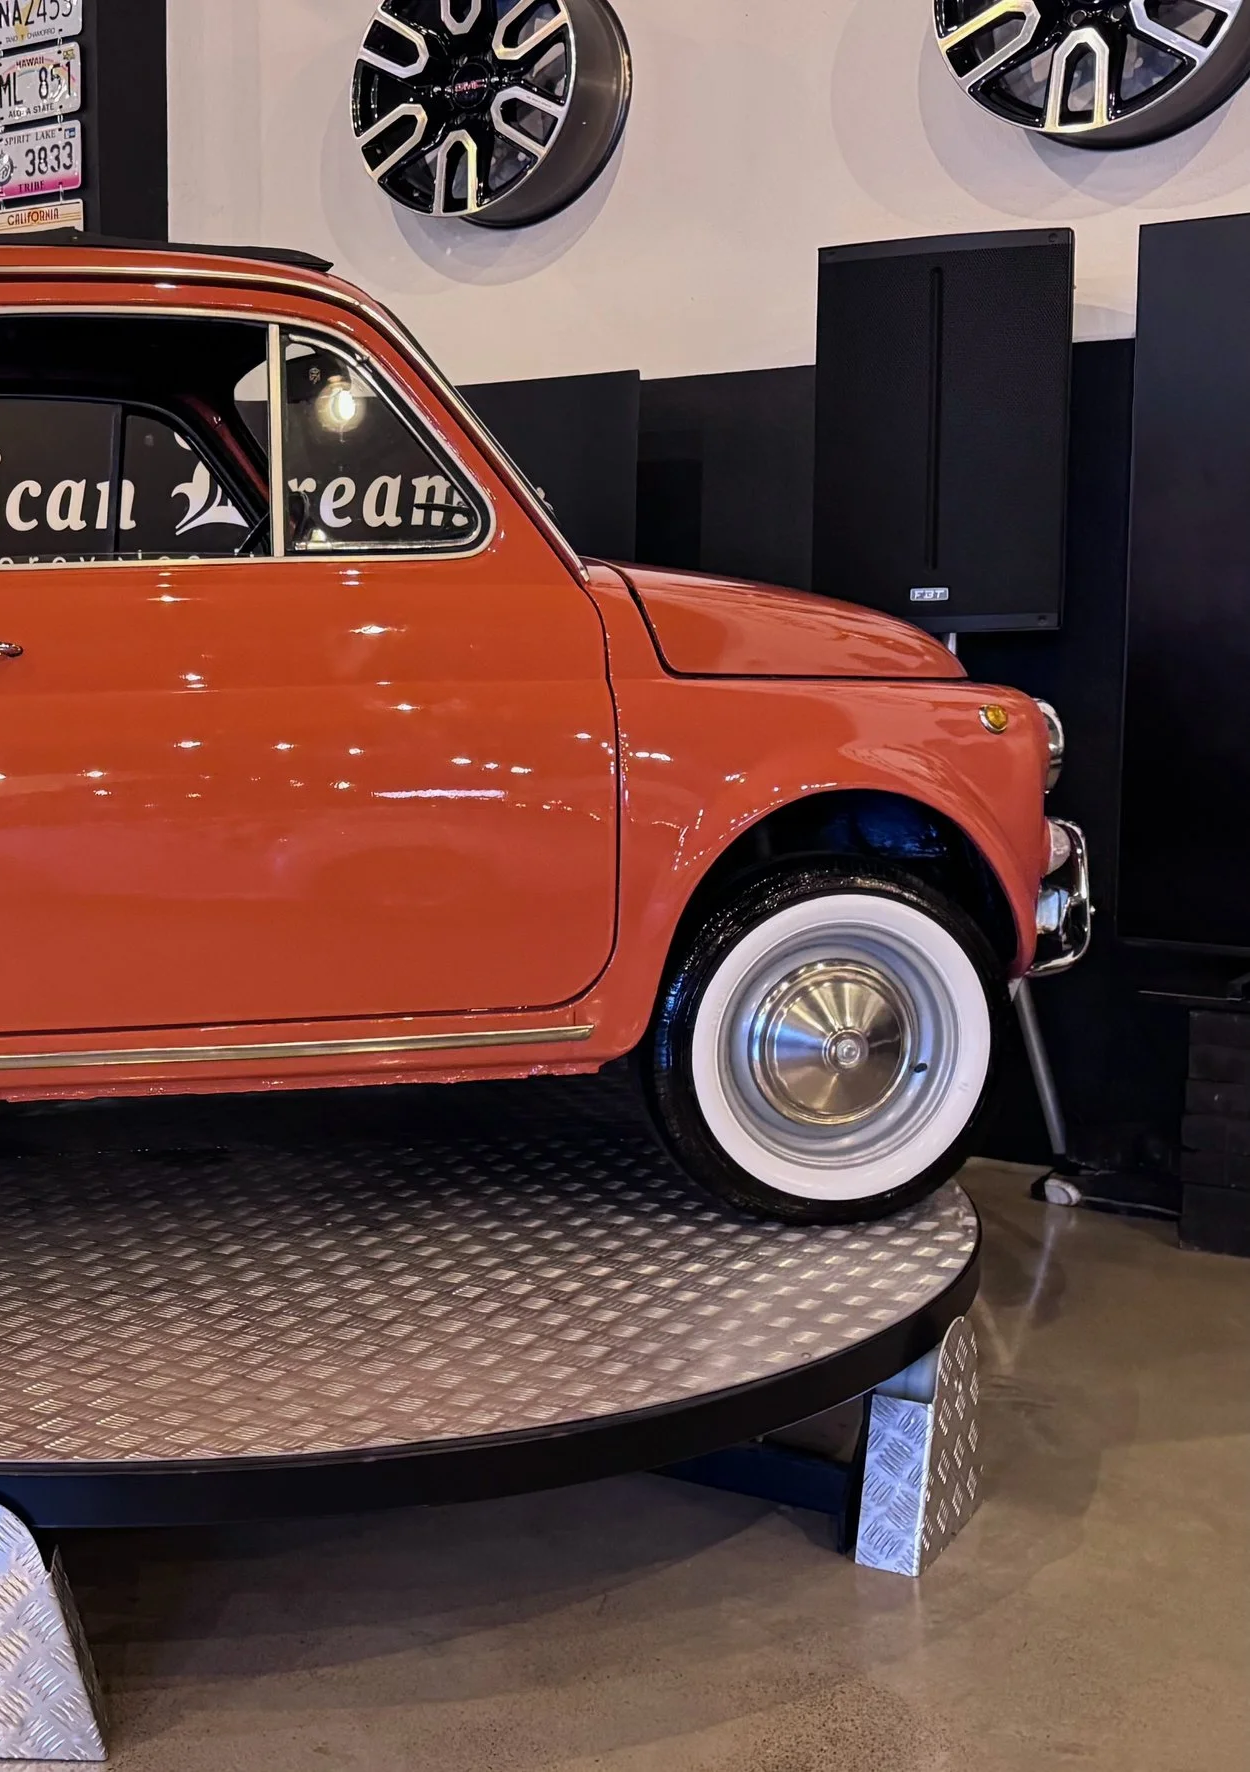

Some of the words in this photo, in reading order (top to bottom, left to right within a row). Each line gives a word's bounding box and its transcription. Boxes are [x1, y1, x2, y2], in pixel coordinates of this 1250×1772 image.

[16, 56, 45, 68] HAWAII
[33, 102, 55, 114] STATE
[4, 133, 31, 146] SPIRIT
[35, 129, 56, 141] LAKE
[24, 141, 74, 177] 3833
[7, 207, 60, 226] CALIFORNIA
[912, 589, 946, 600] FBT
